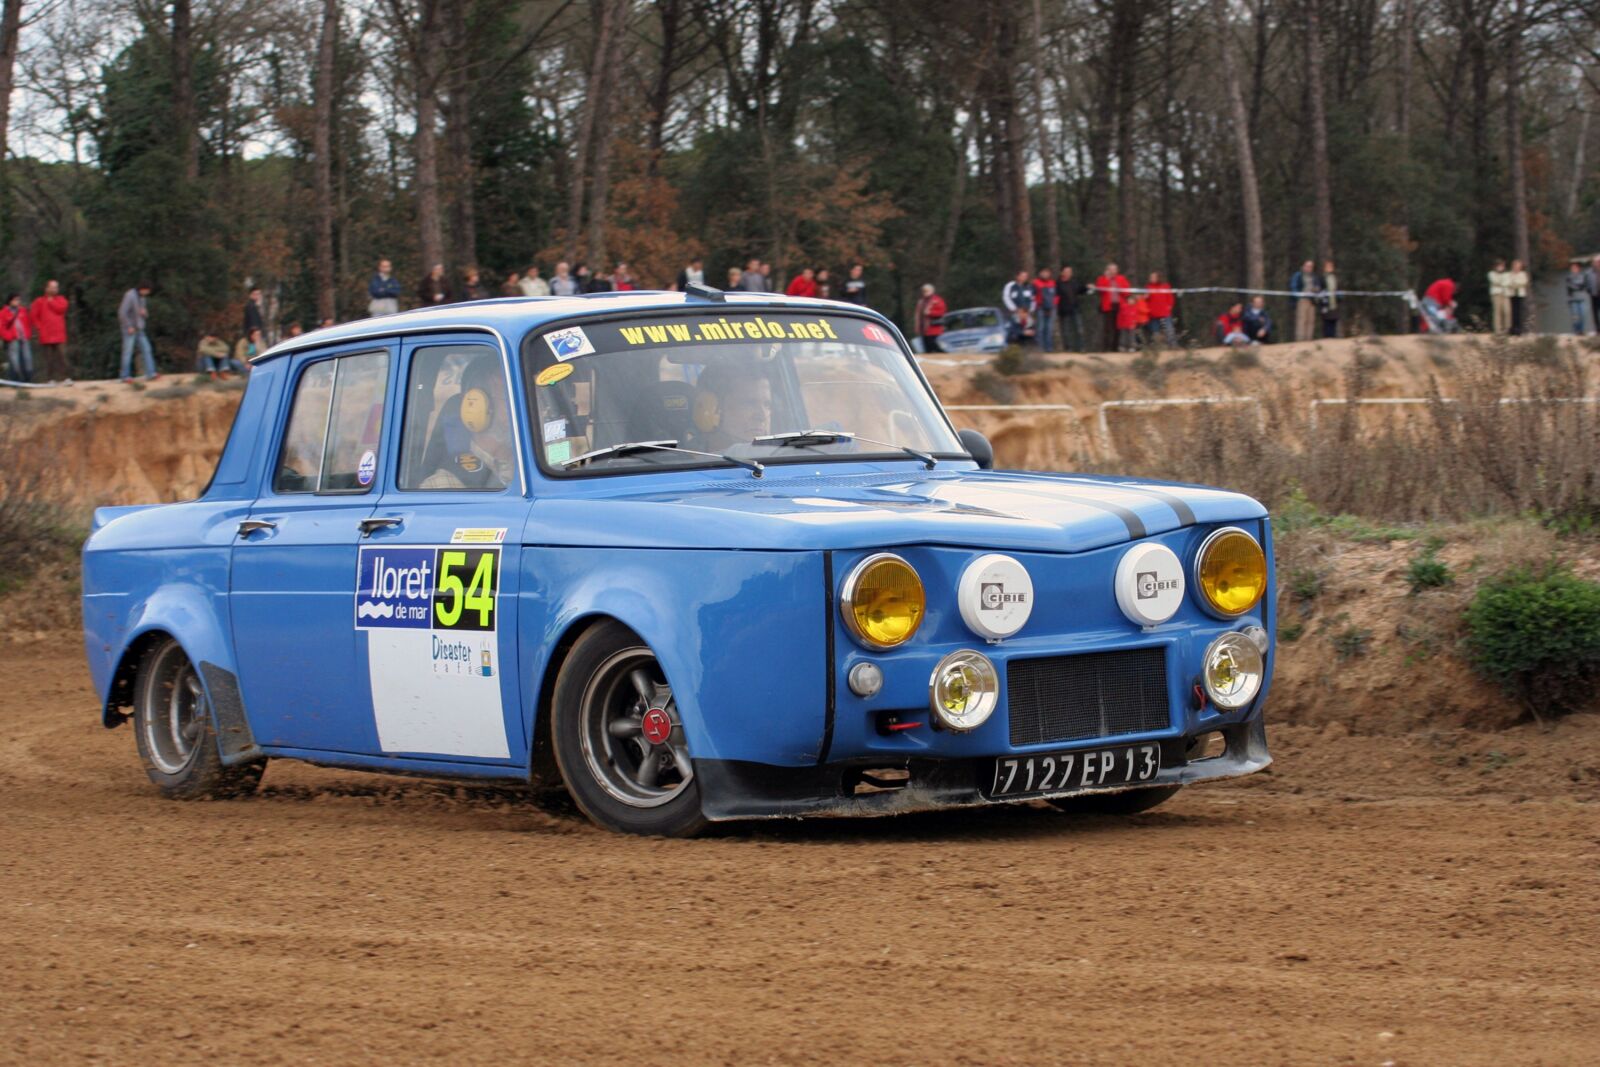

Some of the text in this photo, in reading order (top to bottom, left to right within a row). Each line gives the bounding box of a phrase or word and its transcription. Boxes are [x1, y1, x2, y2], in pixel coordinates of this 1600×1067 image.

[619, 317, 838, 345] www.mirelo.net
[371, 556, 431, 600] lloret
[435, 551, 494, 627] 54
[395, 602, 428, 619] de mar
[432, 634, 472, 662] Disaster
[1000, 746, 1154, 794] 7127 EP 13
